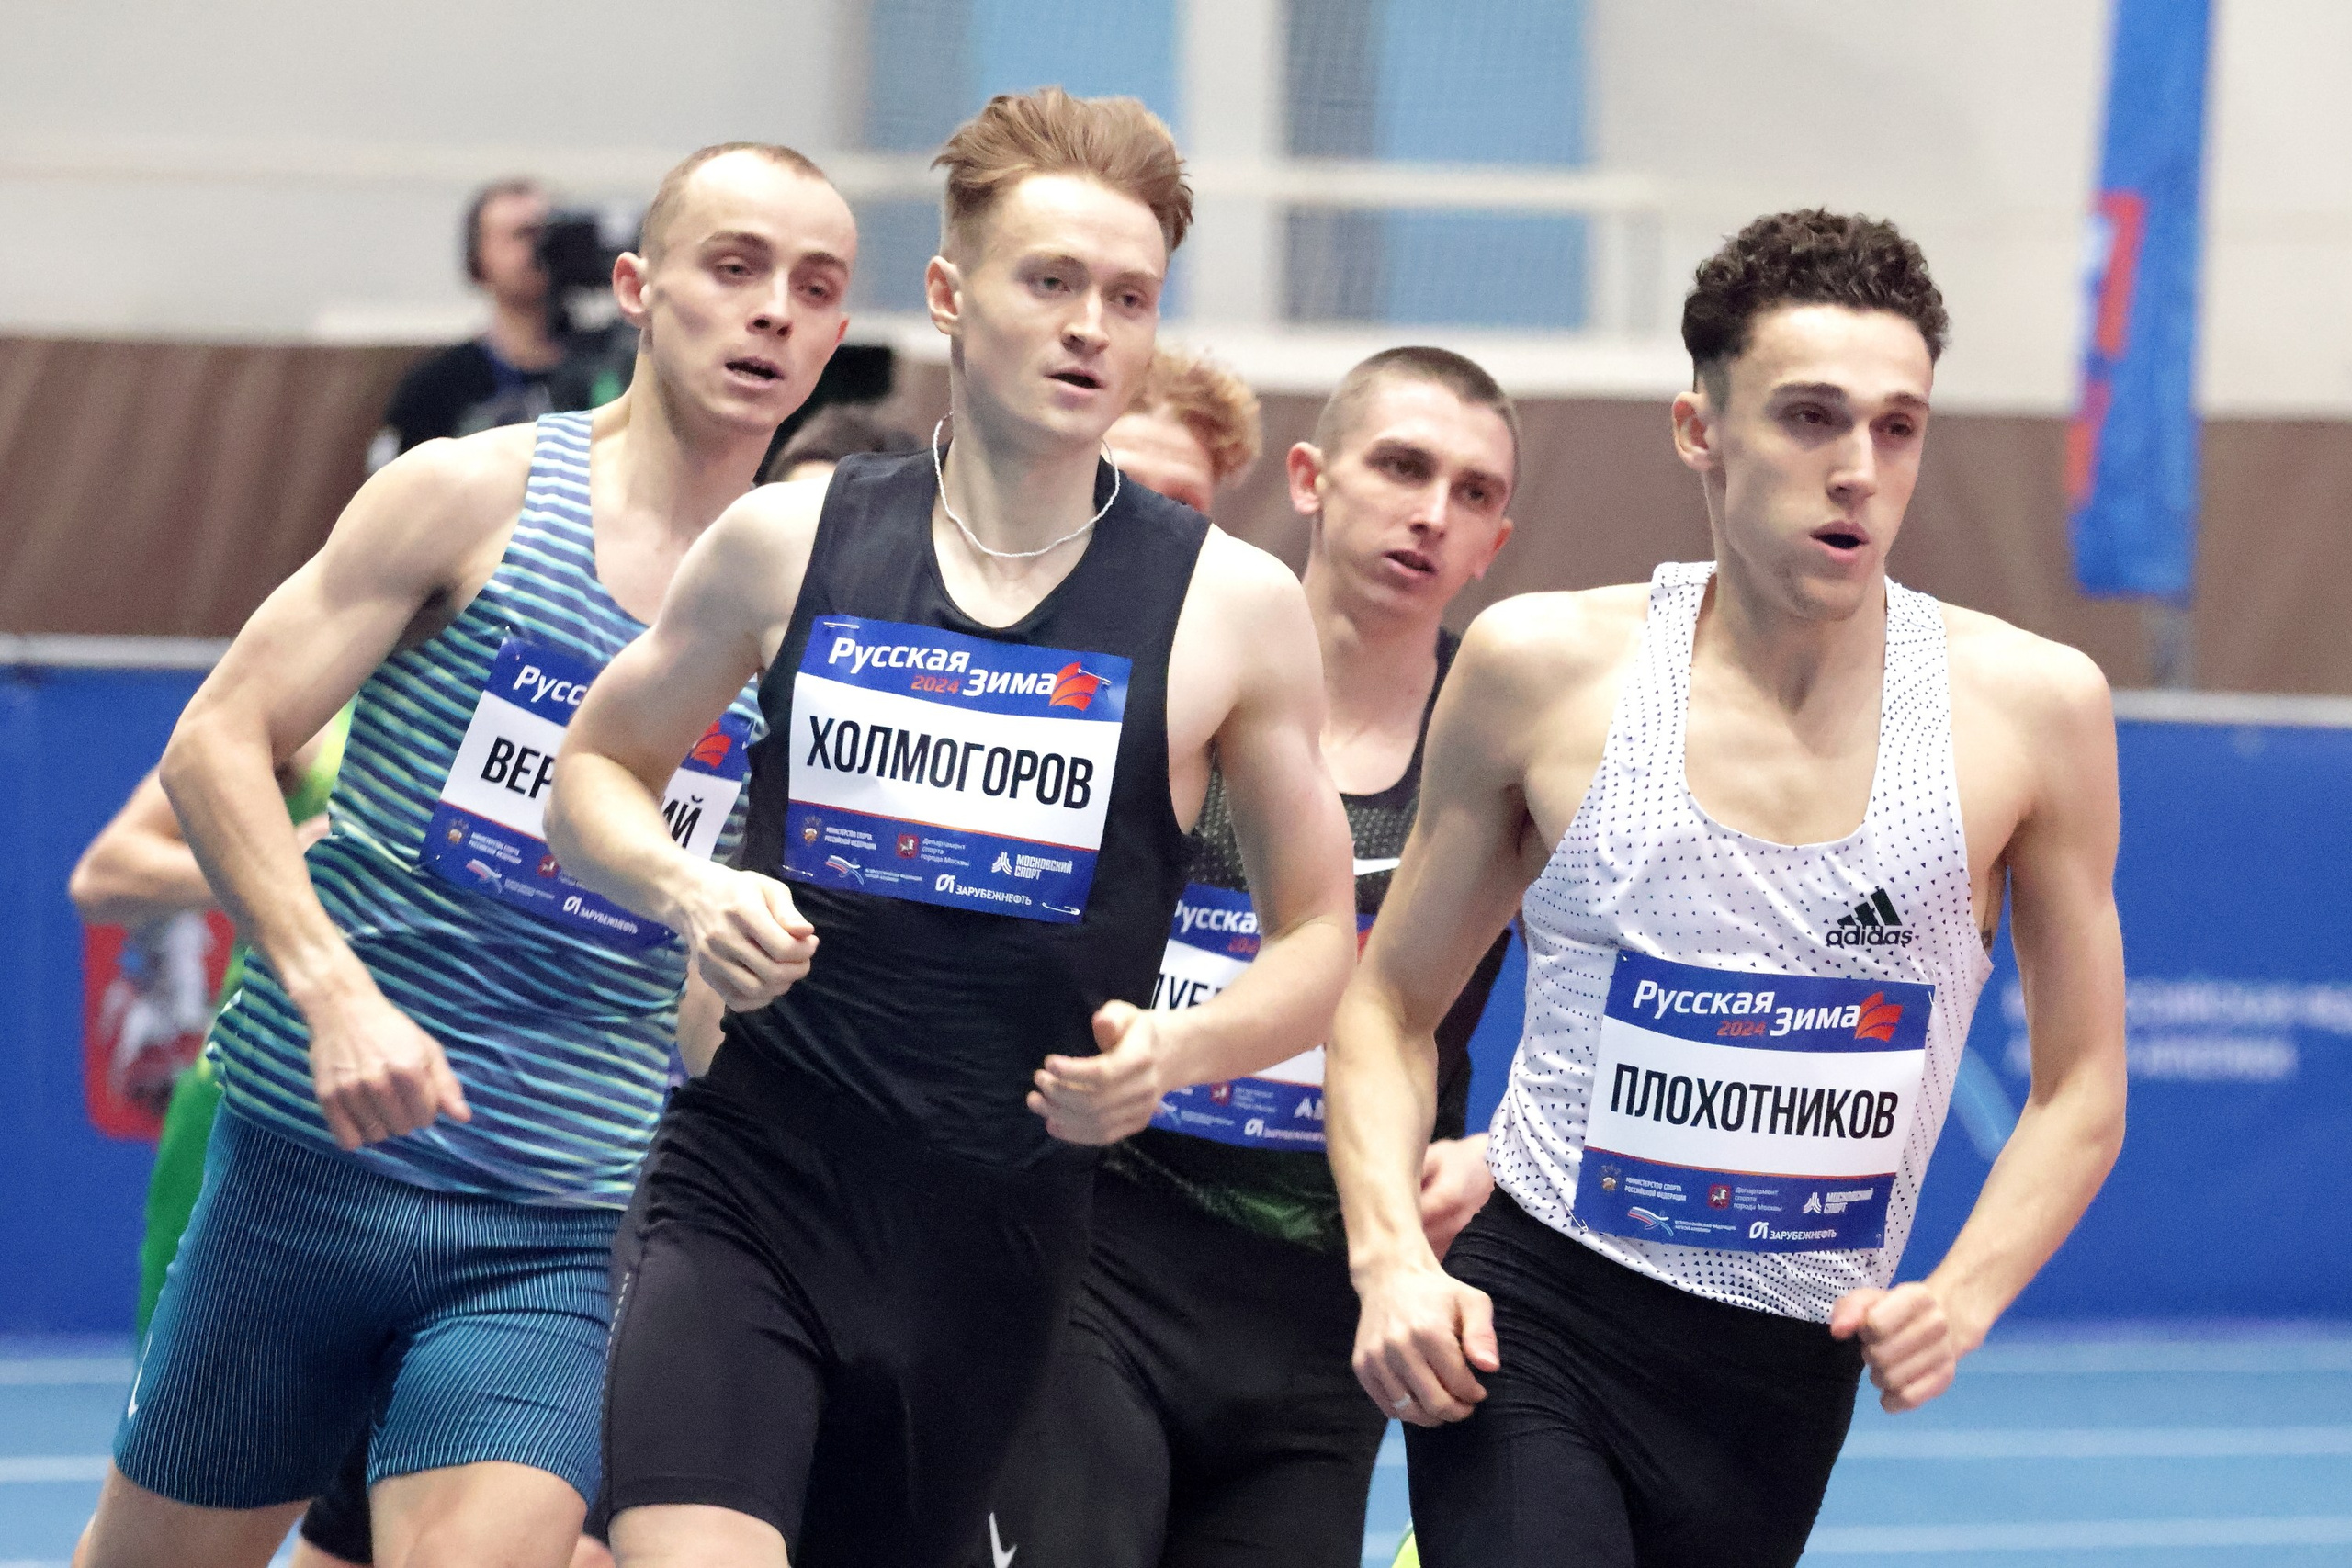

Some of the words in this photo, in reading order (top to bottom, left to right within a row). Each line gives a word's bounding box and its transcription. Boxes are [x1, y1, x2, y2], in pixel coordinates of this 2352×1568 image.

[828, 637, 970, 674] Русская
[963, 669, 1057, 696] Зима
[513, 664, 588, 706] Русс
[910, 675, 960, 694] 2024
[806, 716, 1094, 809] ХОЛМОГОРОВ
[1014, 866, 1042, 880] СПОРТ
[1016, 854, 1073, 874] МОСКОВСКИЙ
[956, 885, 1032, 906] ЗАРУБЕЖНЕФТЬ
[1174, 899, 1260, 935] усска
[1826, 926, 1913, 947] adidas
[1633, 980, 1775, 1019] Русская
[1770, 1003, 1861, 1036] Зима
[1716, 1020, 1766, 1037] 2024
[1611, 1063, 1898, 1140] ПЛОХОТНИКОВ
[1770, 1229, 1837, 1240] ЗАРУБЕЖНЕФТЬ
